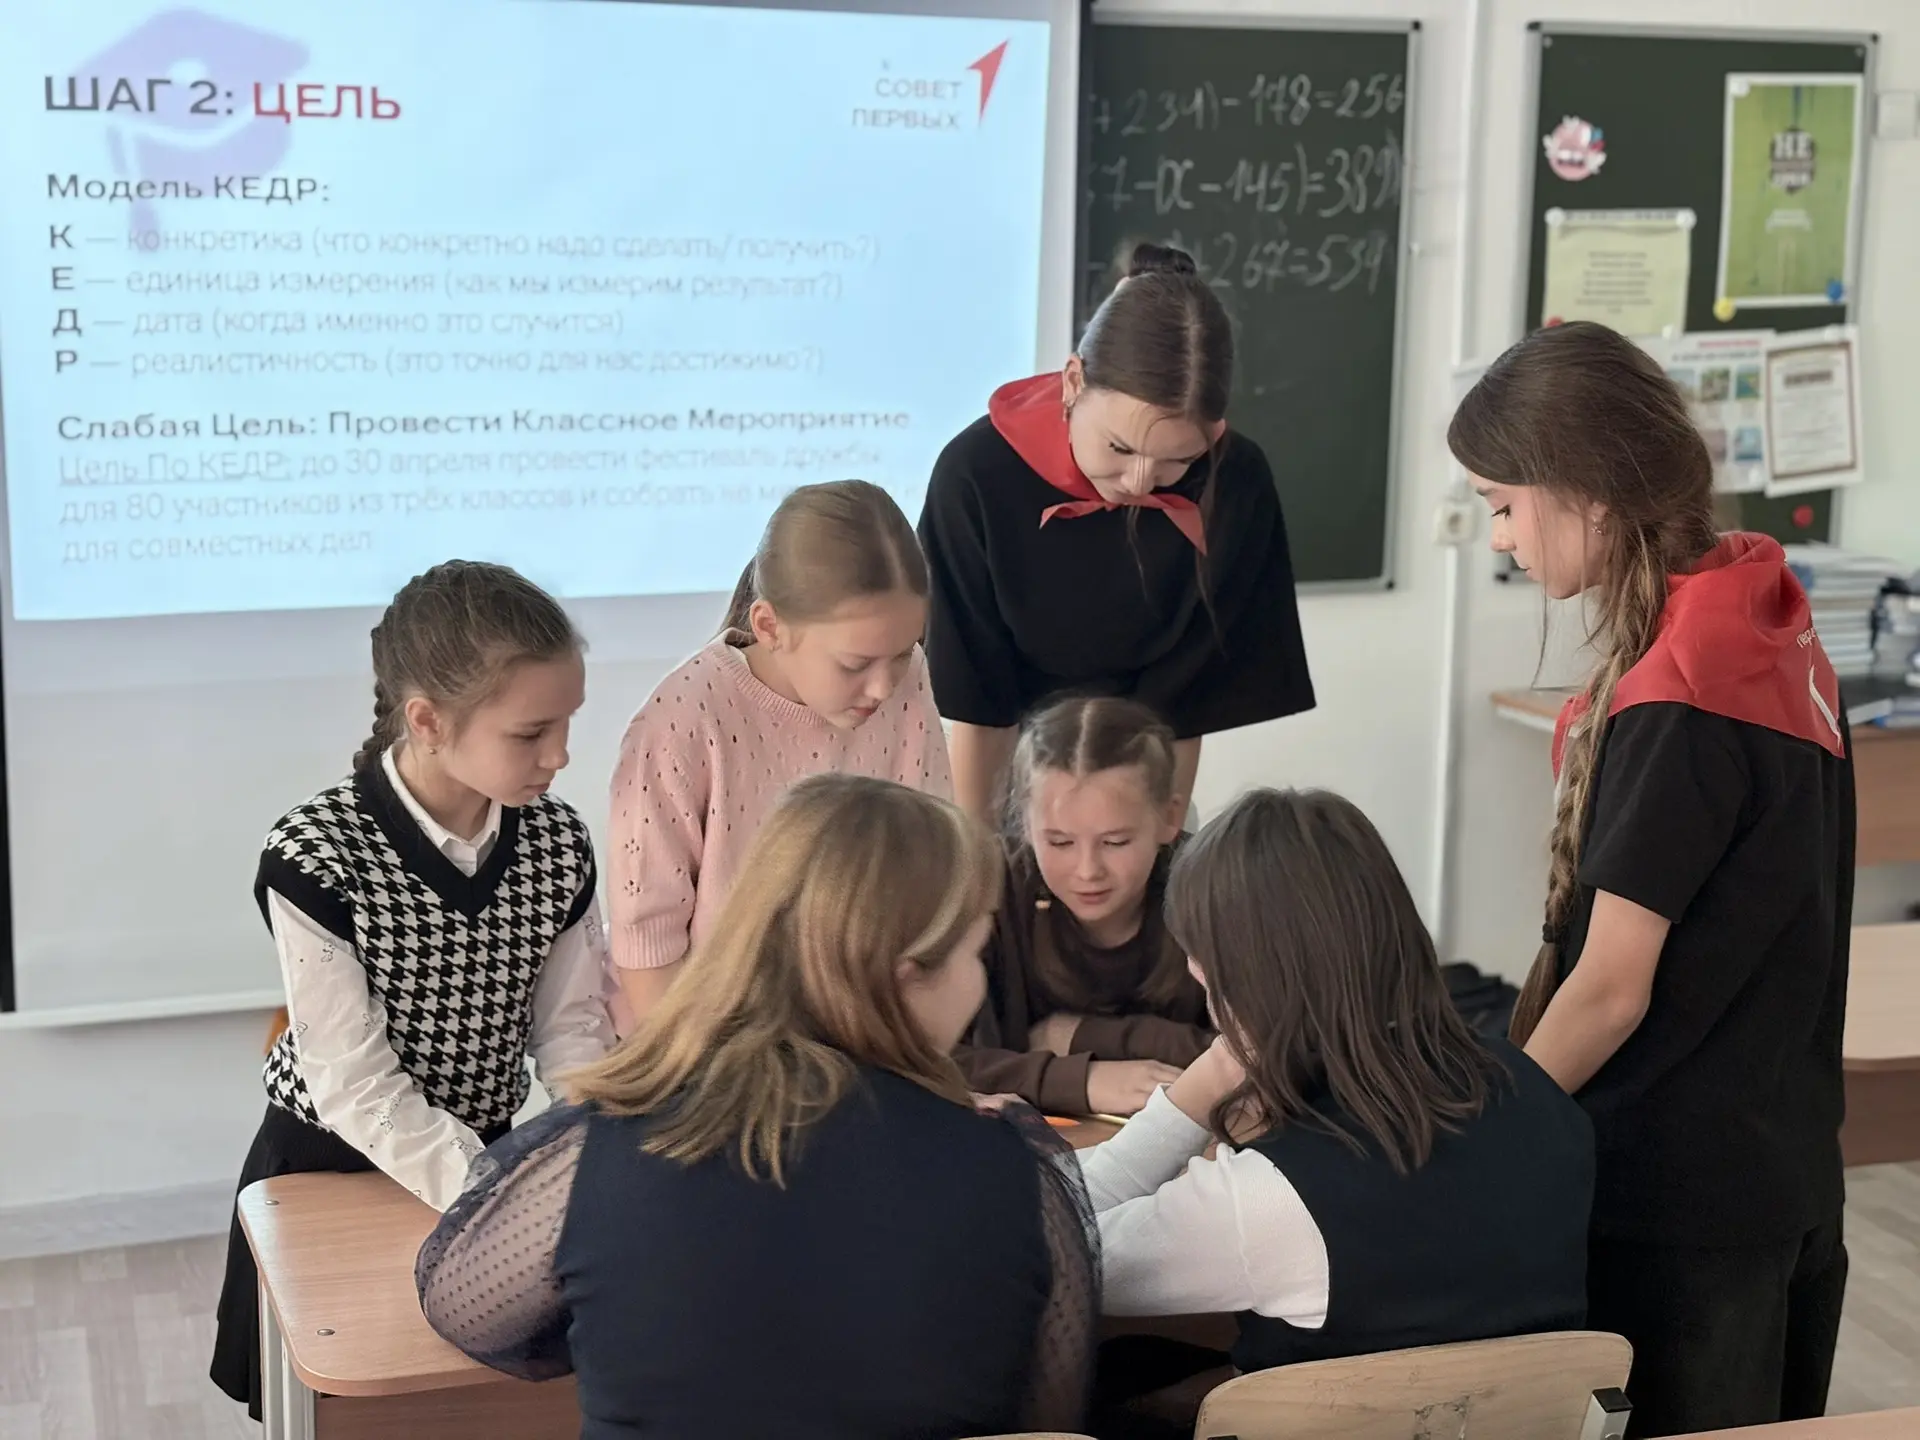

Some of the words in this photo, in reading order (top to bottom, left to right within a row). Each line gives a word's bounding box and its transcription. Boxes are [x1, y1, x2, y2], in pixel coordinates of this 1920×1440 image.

[44, 75, 172, 113] ШАГ
[188, 80, 235, 116] 2:
[253, 81, 402, 124] ЦЕЛЬ
[874, 77, 963, 99] СОВЕТ
[851, 107, 961, 130] ПЕРВЫХ
[46, 173, 203, 204] Модель
[213, 174, 331, 205] КЕДР:
[48, 224, 75, 250] К
[127, 228, 304, 254] конкретика
[311, 226, 372, 257] (что
[378, 230, 528, 258] конкретно
[537, 235, 605, 260] надо
[51, 266, 76, 291] Е
[126, 271, 260, 296] единица
[269, 271, 435, 297] измерения
[444, 269, 499, 298] (как
[508, 275, 550, 294] мы
[557, 275, 684, 300] измерим
[691, 271, 844, 301] результат?)
[51, 308, 83, 337] Д
[132, 312, 202, 337] дата
[212, 309, 307, 339] (когда
[317, 313, 429, 334] именно
[436, 312, 484, 334] это
[490, 310, 624, 338] случится)
[54, 350, 80, 375] Р
[131, 351, 378, 379] реалистичность
[384, 349, 444, 378] (это
[451, 351, 532, 373] точно
[537, 351, 587, 376] для
[595, 351, 645, 372] нас
[648, 346, 825, 377] достижимо?)
[57, 413, 201, 440] Слабая
[211, 411, 319, 443] Цель:
[328, 411, 501, 440] Провести
[512, 407, 679, 433] Классное
[687, 407, 911, 436] Мероприятие
[58, 453, 138, 485] Цель
[146, 452, 191, 483] По
[299, 453, 339, 478] до
[344, 448, 382, 475] 30
[388, 449, 490, 478] апреля
[499, 448, 628, 476] провести
[634, 444, 777, 473] фестиваль
[58, 499, 118, 525] для
[126, 492, 165, 520] 80
[172, 494, 341, 523] участников
[350, 493, 384, 514] из
[391, 485, 454, 515] трёх
[460, 484, 574, 511] классов
[604, 481, 714, 509] собрать
[62, 538, 118, 565] для
[127, 532, 313, 562] совместных
[318, 531, 373, 556] дел
